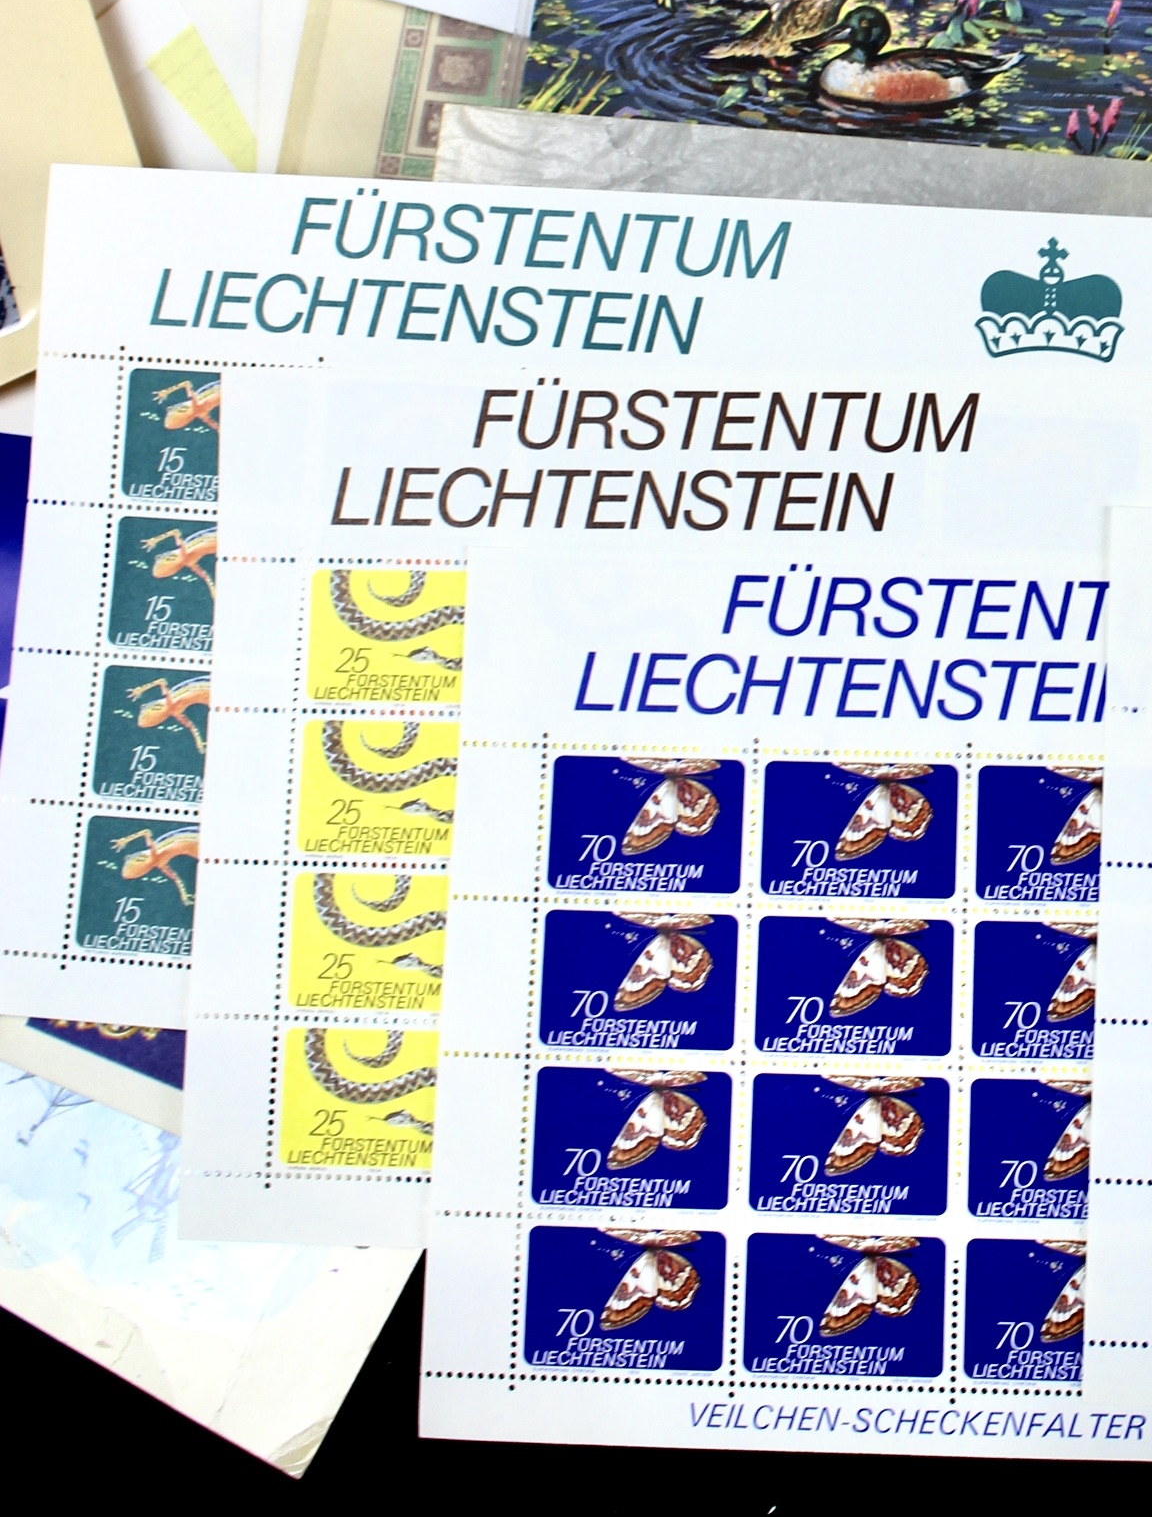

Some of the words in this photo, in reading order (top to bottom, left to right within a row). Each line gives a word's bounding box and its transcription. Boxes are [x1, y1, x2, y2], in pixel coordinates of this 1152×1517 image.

[291, 187, 791, 280] FÜRSTENTUM
[149, 268, 704, 355] LIECHTENSTEIN
[473, 378, 979, 452] FÜRSTENTUM
[157, 447, 188, 473] 15
[331, 467, 894, 532] LIECHTENSTEIN
[144, 596, 173, 621] 15
[335, 647, 373, 674] 25
[314, 686, 441, 701] LIECHTENSTEIN
[129, 745, 160, 772] 15
[325, 798, 364, 825] 25
[305, 838, 432, 855] LIECHTENSTEIN
[577, 834, 617, 863] 70
[791, 840, 830, 868] 70
[554, 874, 687, 892] LIECHTENSTEIN
[768, 879, 901, 898] LIECHTENSTEIN
[112, 897, 143, 924] 15
[317, 952, 356, 980] 25
[295, 993, 425, 1010] LIECHTENSTEIN
[570, 990, 608, 1019] 70
[548, 1031, 679, 1049] LIECHTENSTEIN
[308, 1109, 348, 1137] 25
[287, 1150, 417, 1168] LIECHTENSTEIN
[780, 1155, 819, 1183] 70
[757, 1196, 892, 1214] LIECHTENSTEIN
[556, 1309, 595, 1338] 70
[775, 1316, 814, 1345] 70
[532, 1350, 667, 1368] LIECHTENSTEIN
[753, 1357, 887, 1375] LIECHTENSTEIN
[689, 1402, 1147, 1441] VEILCHEN-SCHECKENFALTER
